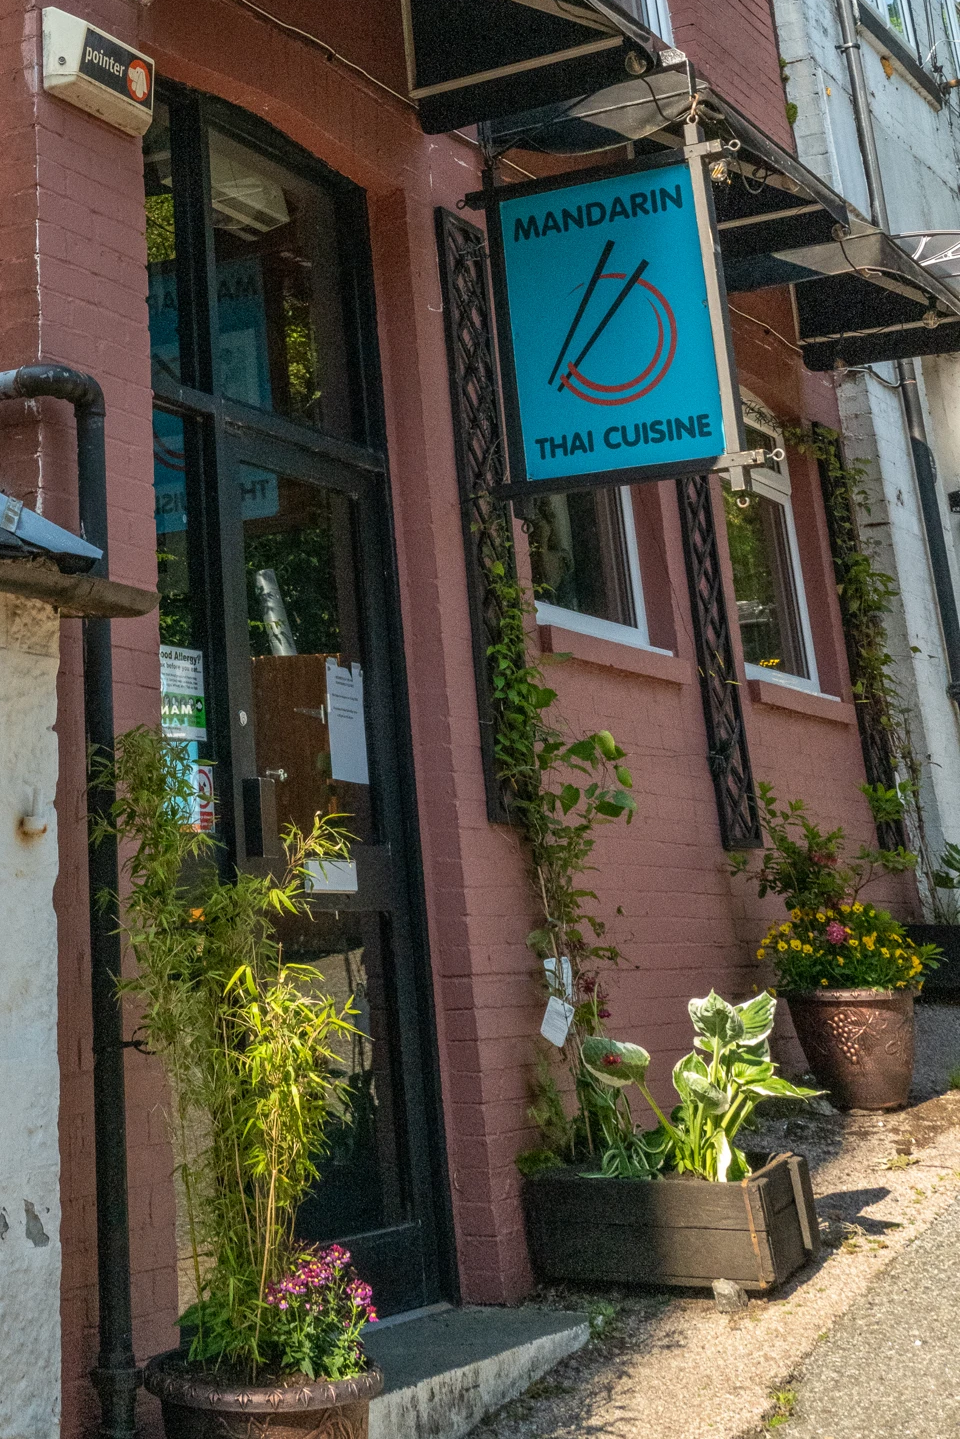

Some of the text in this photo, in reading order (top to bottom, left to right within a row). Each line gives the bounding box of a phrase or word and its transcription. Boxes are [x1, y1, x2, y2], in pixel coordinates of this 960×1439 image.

[85, 46, 126, 78] pointer
[513, 184, 684, 242] MANDARIN
[535, 414, 713, 460] THAI CUISINE
[160, 650, 172, 660] ood
[174, 651, 201, 666] Allergy?
